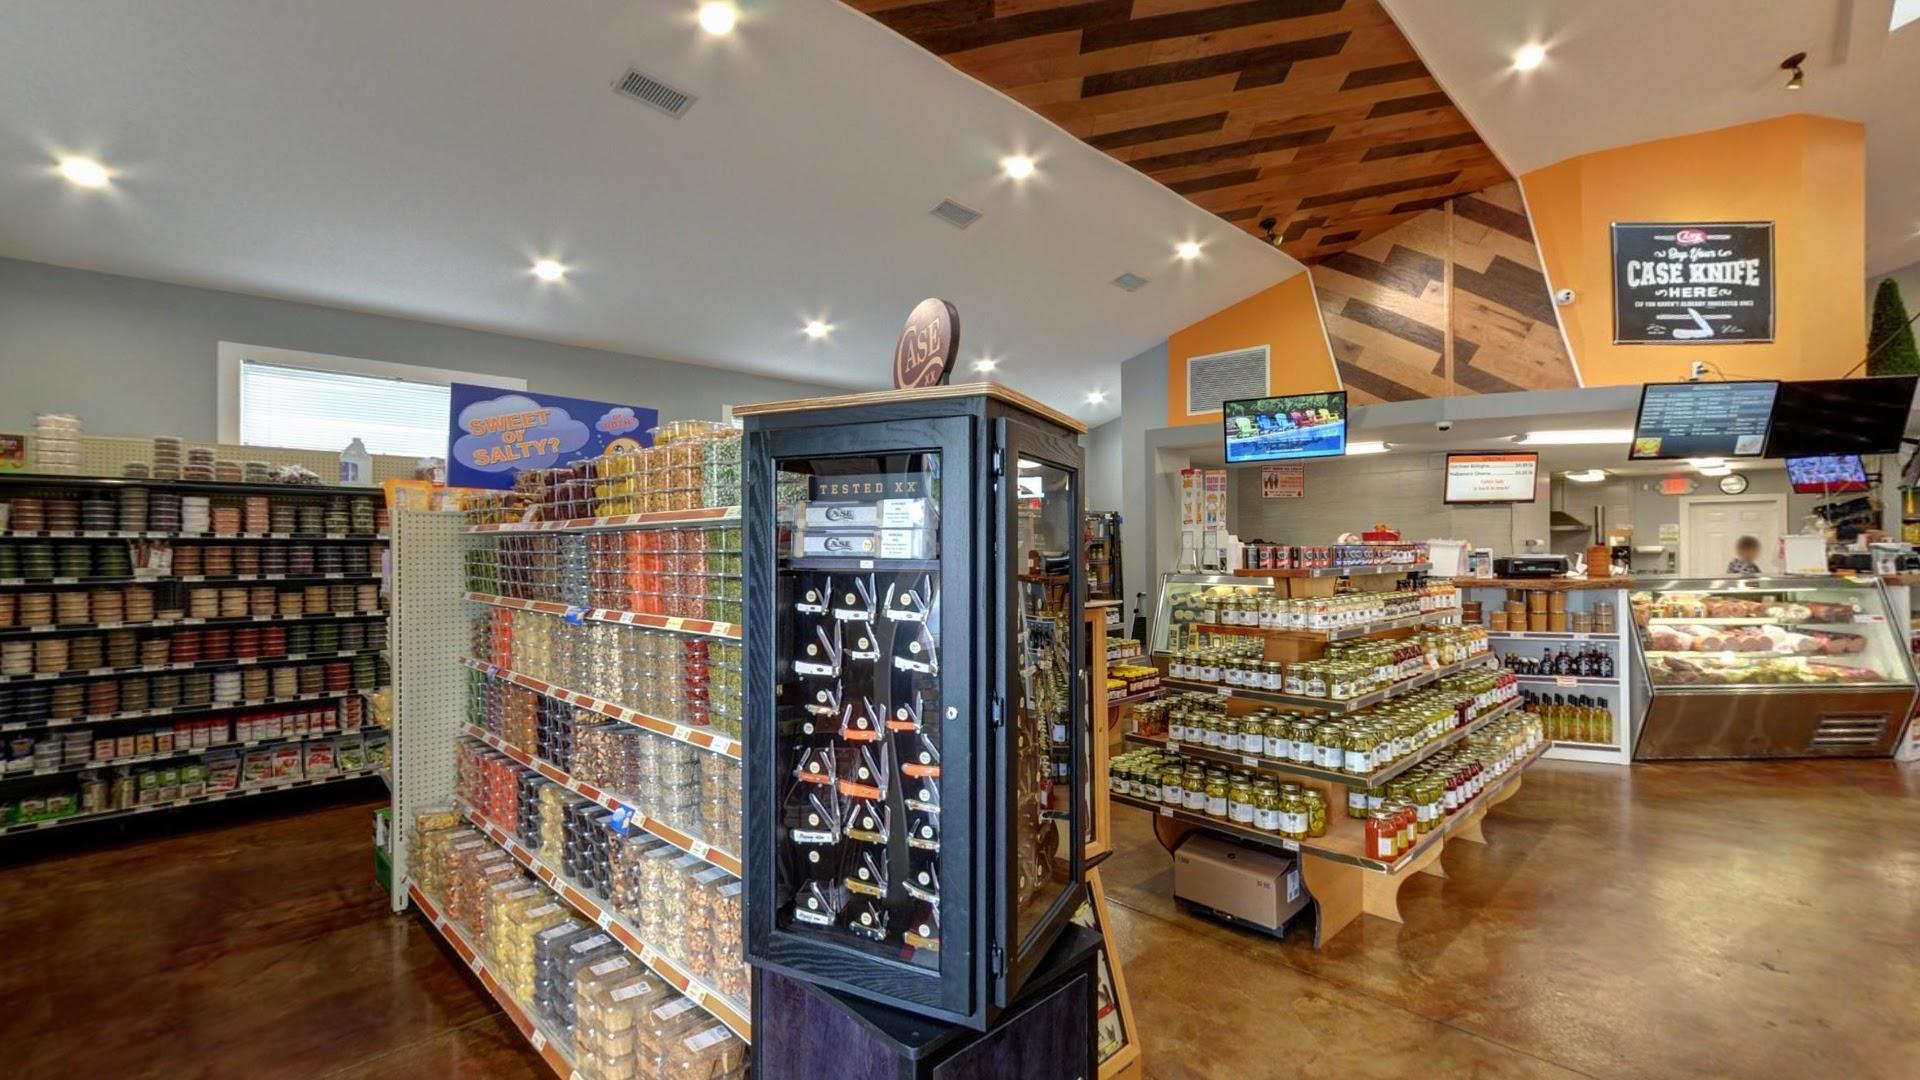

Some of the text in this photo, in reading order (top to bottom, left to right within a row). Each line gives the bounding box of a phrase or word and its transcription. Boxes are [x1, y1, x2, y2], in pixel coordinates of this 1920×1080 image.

[1627, 259, 1760, 288] CASE KNIFE
[1669, 287, 1718, 298] HERE
[897, 316, 943, 388] CASE
[469, 409, 550, 437] SWEET
[472, 437, 560, 467] SALTY?
[819, 482, 918, 495] TESTED XX
[825, 505, 855, 522] CASE
[824, 536, 853, 552] CASE
